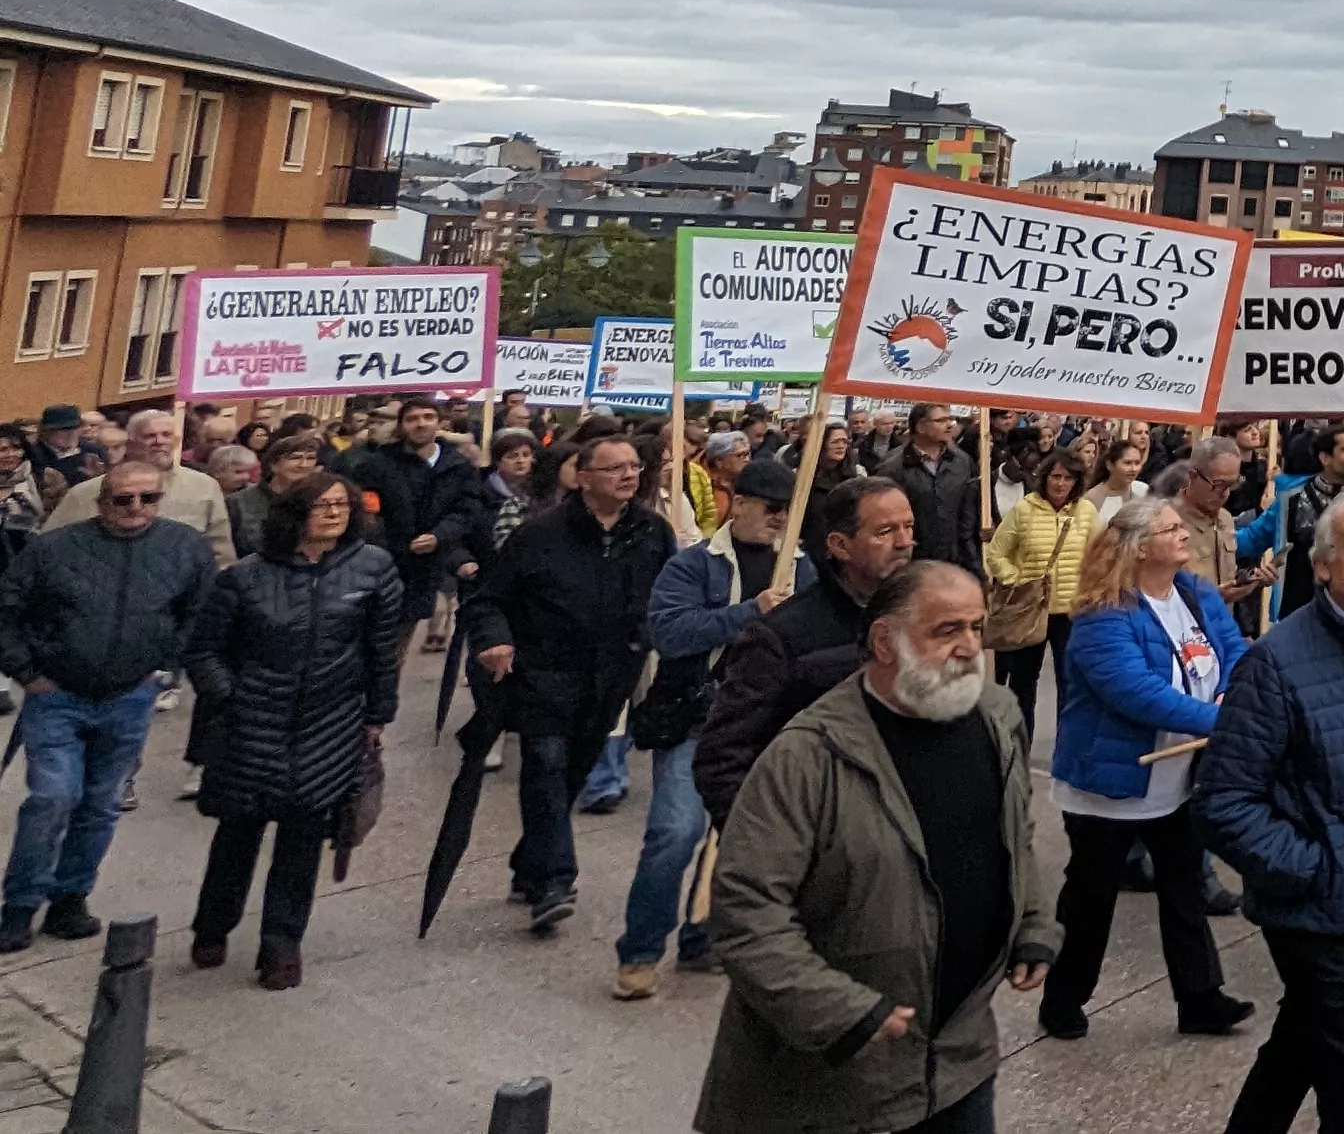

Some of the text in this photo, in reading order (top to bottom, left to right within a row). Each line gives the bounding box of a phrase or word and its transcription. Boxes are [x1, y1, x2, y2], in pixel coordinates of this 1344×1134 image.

[892, 203, 1218, 278] ¿ENERGÍAS
[733, 251, 747, 269] EL
[700, 272, 845, 304] COMUNIDADES
[911, 243, 1189, 311] LIMPIAS?
[206, 280, 481, 320] ¿GENERARÁN EMPLEO?
[347, 317, 475, 339] NO ES VERDAD
[984, 296, 1204, 364] SI, PERO...
[232, 355, 308, 376] FUENTE
[336, 350, 471, 382] FALSO
[603, 346, 675, 364] RENOVA
[700, 351, 716, 368] de
[1245, 350, 1344, 386] PERO
[967, 356, 1197, 396] sin joder nuestro Bierzo
